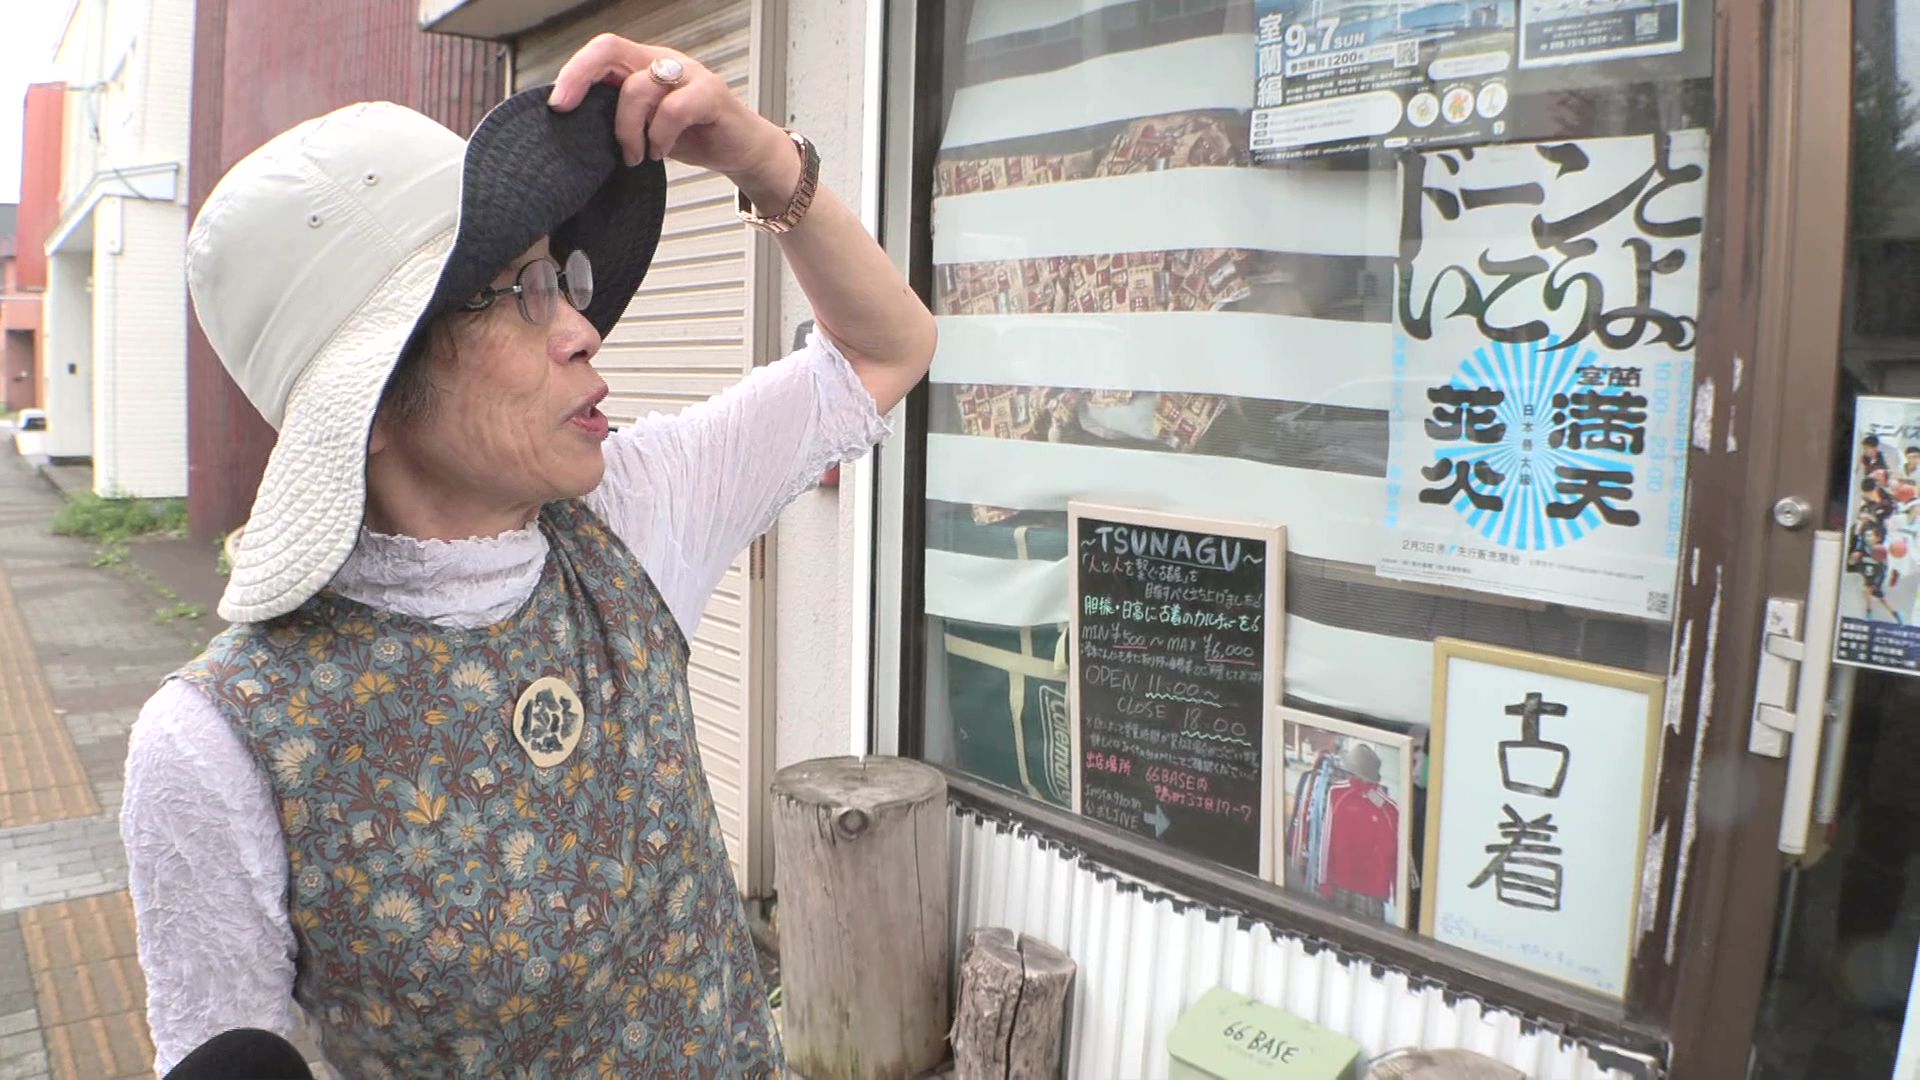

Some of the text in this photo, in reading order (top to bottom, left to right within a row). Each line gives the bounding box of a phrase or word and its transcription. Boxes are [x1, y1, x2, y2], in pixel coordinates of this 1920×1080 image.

[1285, 16, 1365, 57] 9.7 SUN
[1257, 12, 1283, 108] 室蘭編
[1399, 132, 1703, 264] ドーンと
[1081, 625, 1110, 641] MIN
[1166, 637, 1197, 652] MAX
[1085, 665, 1139, 691] OPEN
[1116, 697, 1168, 719] CLOSE
[1467, 691, 1570, 912] 古着
[1223, 1021, 1299, 1065] 66 BASE
